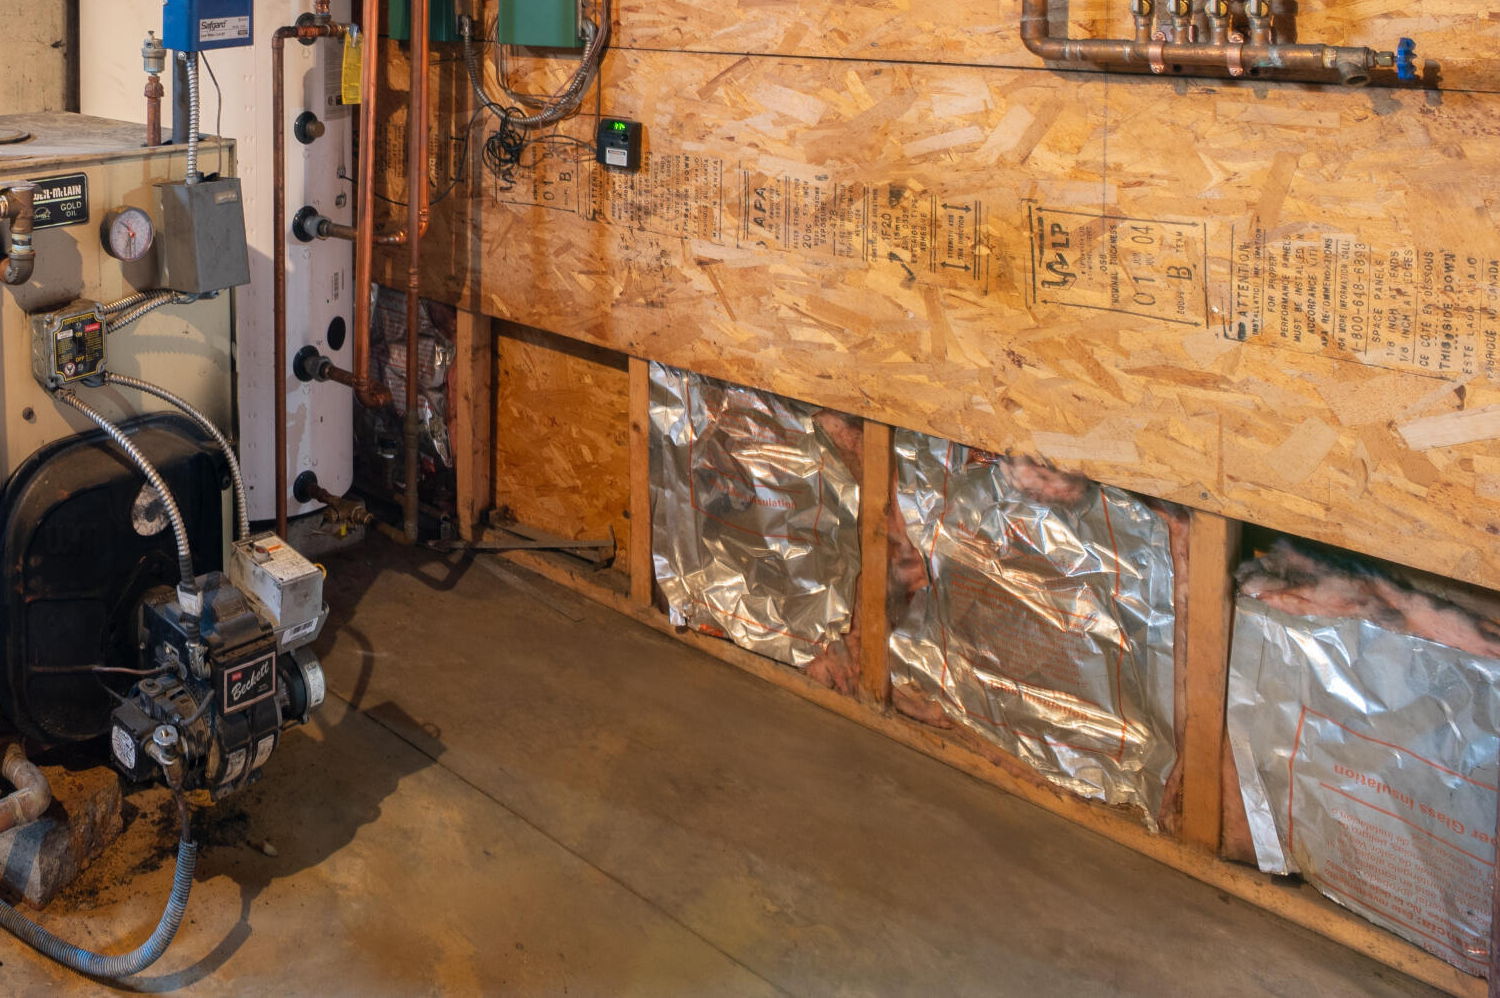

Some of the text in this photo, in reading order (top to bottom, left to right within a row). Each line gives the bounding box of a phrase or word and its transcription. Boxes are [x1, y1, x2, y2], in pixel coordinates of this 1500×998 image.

[60, 201, 82, 211] GOLD
[753, 187, 766, 230] APA
[1166, 265, 1192, 281] B
[1389, 251, 1399, 277] ENDS
[1403, 249, 1413, 283] EDGES
[1423, 252, 1434, 296] DESSOUS
[1443, 253, 1456, 293] DOWN
[1488, 260, 1499, 301] CANADA
[1110, 272, 1120, 304] NOMINAL
[1268, 255, 1276, 313] FOR PROPER
[1280, 234, 1291, 338] PERFORMANCE PANELS
[1372, 260, 1384, 342] SPACE PANELS
[1389, 286, 1397, 300] AT
[1403, 292, 1411, 306] AT
[1294, 302, 1302, 312] BE
[1307, 274, 1317, 334] ACCORDANCE
[1387, 308, 1397, 332] INCH
[1293, 318, 1302, 342] MUST
[1401, 314, 1411, 339] INCH
[1463, 345, 1474, 374] ESTE
[231, 661, 270, 701] Beckett
[1334, 764, 1415, 811] Insulation
[1419, 803, 1465, 838] Glass
